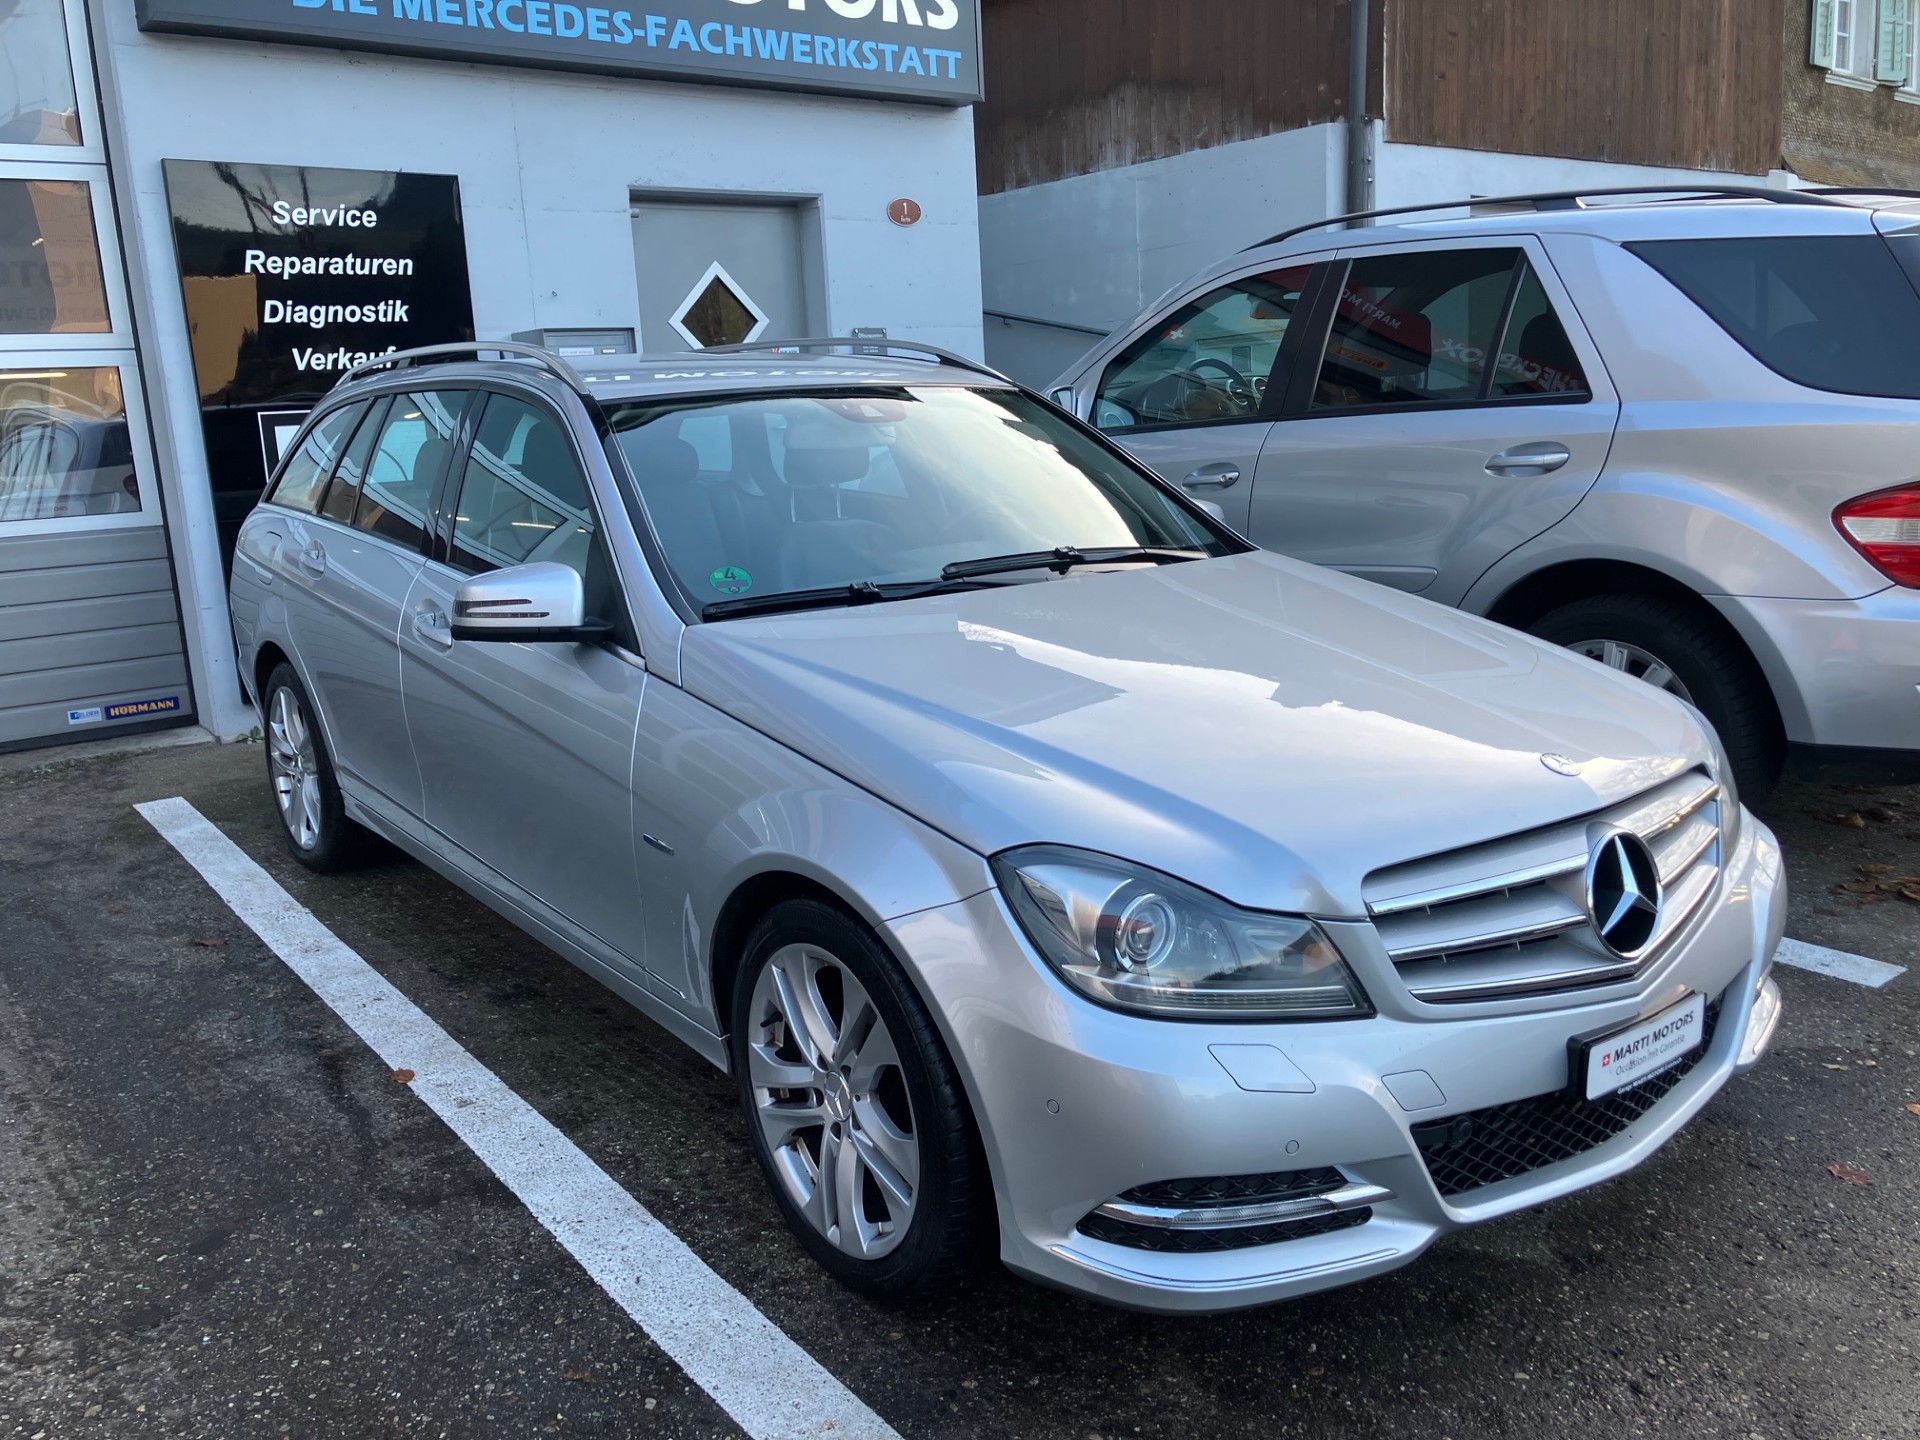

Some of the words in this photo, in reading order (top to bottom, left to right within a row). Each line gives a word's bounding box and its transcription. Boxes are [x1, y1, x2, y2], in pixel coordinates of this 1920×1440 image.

[393, 0, 962, 79] MERCEDES-FACHWERKSTATT
[272, 200, 377, 228] Service
[902, 202, 908, 215] 1
[244, 249, 414, 280] Reparaturen
[263, 299, 410, 329] Diagnostik
[292, 346, 396, 371] Verkauf
[724, 567, 737, 580] 4
[1614, 1035, 1650, 1062] MARTI
[1652, 1011, 1694, 1042] MOTORS
